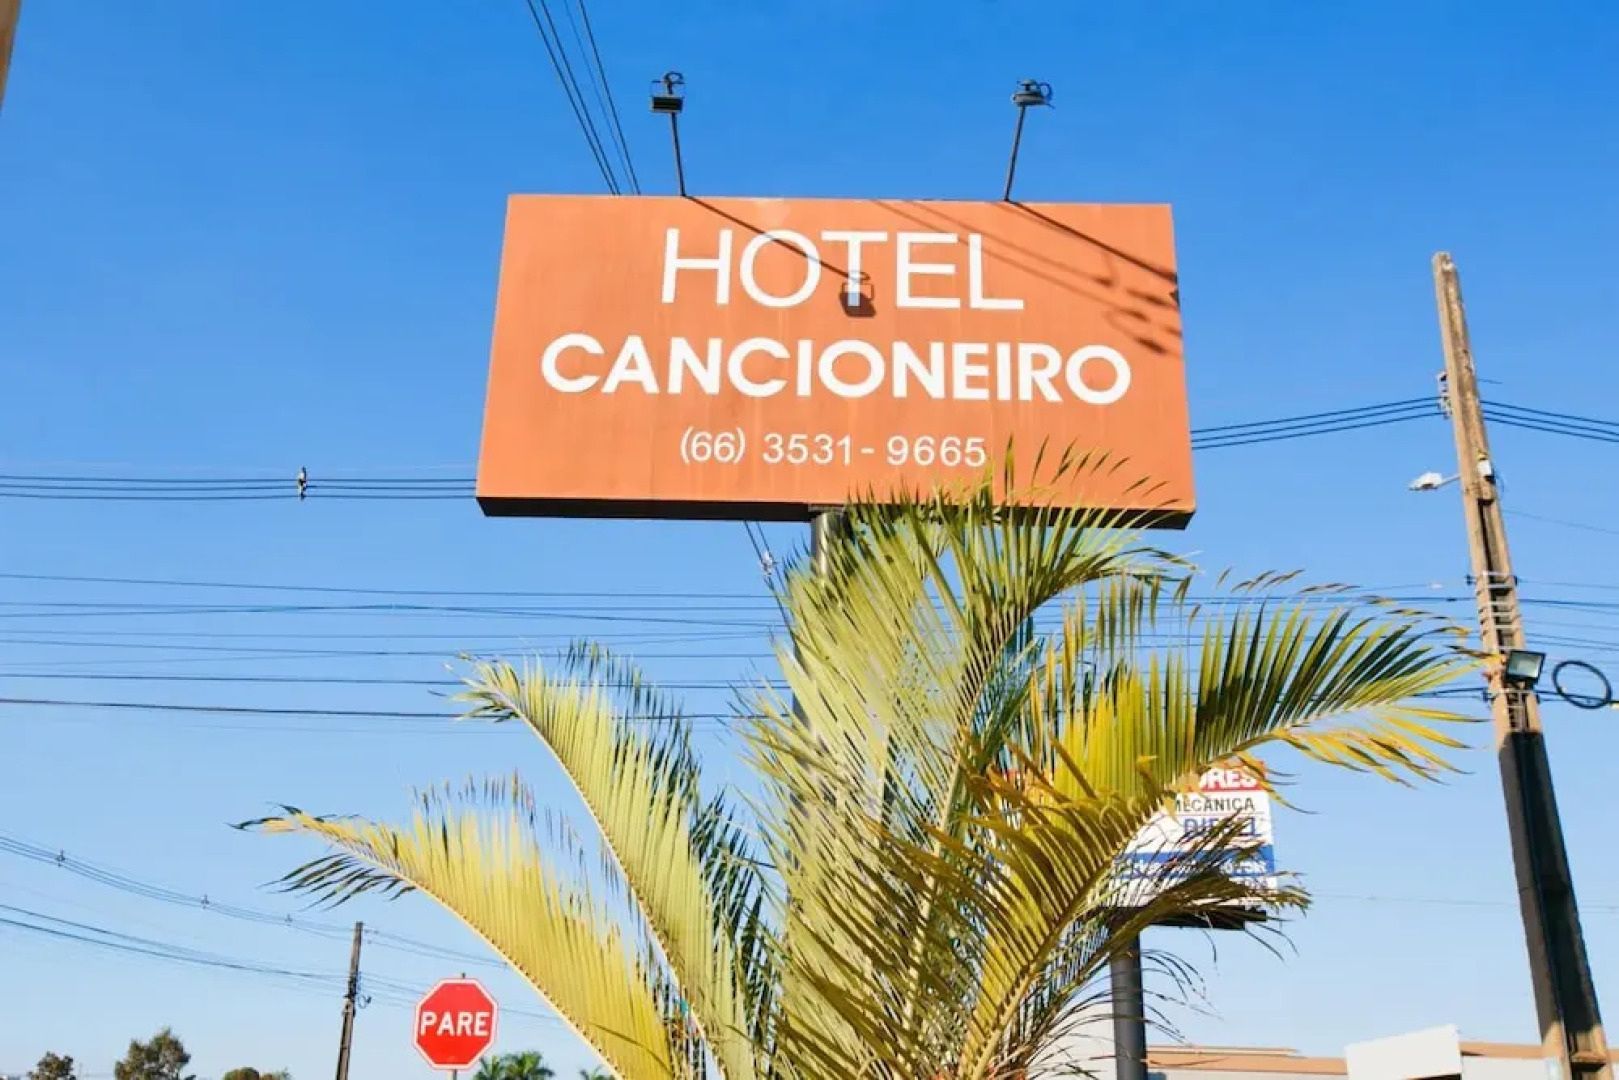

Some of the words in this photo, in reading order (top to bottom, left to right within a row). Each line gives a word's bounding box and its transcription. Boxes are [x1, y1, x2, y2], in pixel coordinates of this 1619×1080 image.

[661, 228, 1025, 311] HOTEL
[541, 333, 1132, 405] CANCIONEIRO
[680, 427, 745, 464] (66)
[420, 1011, 491, 1037] PARE
